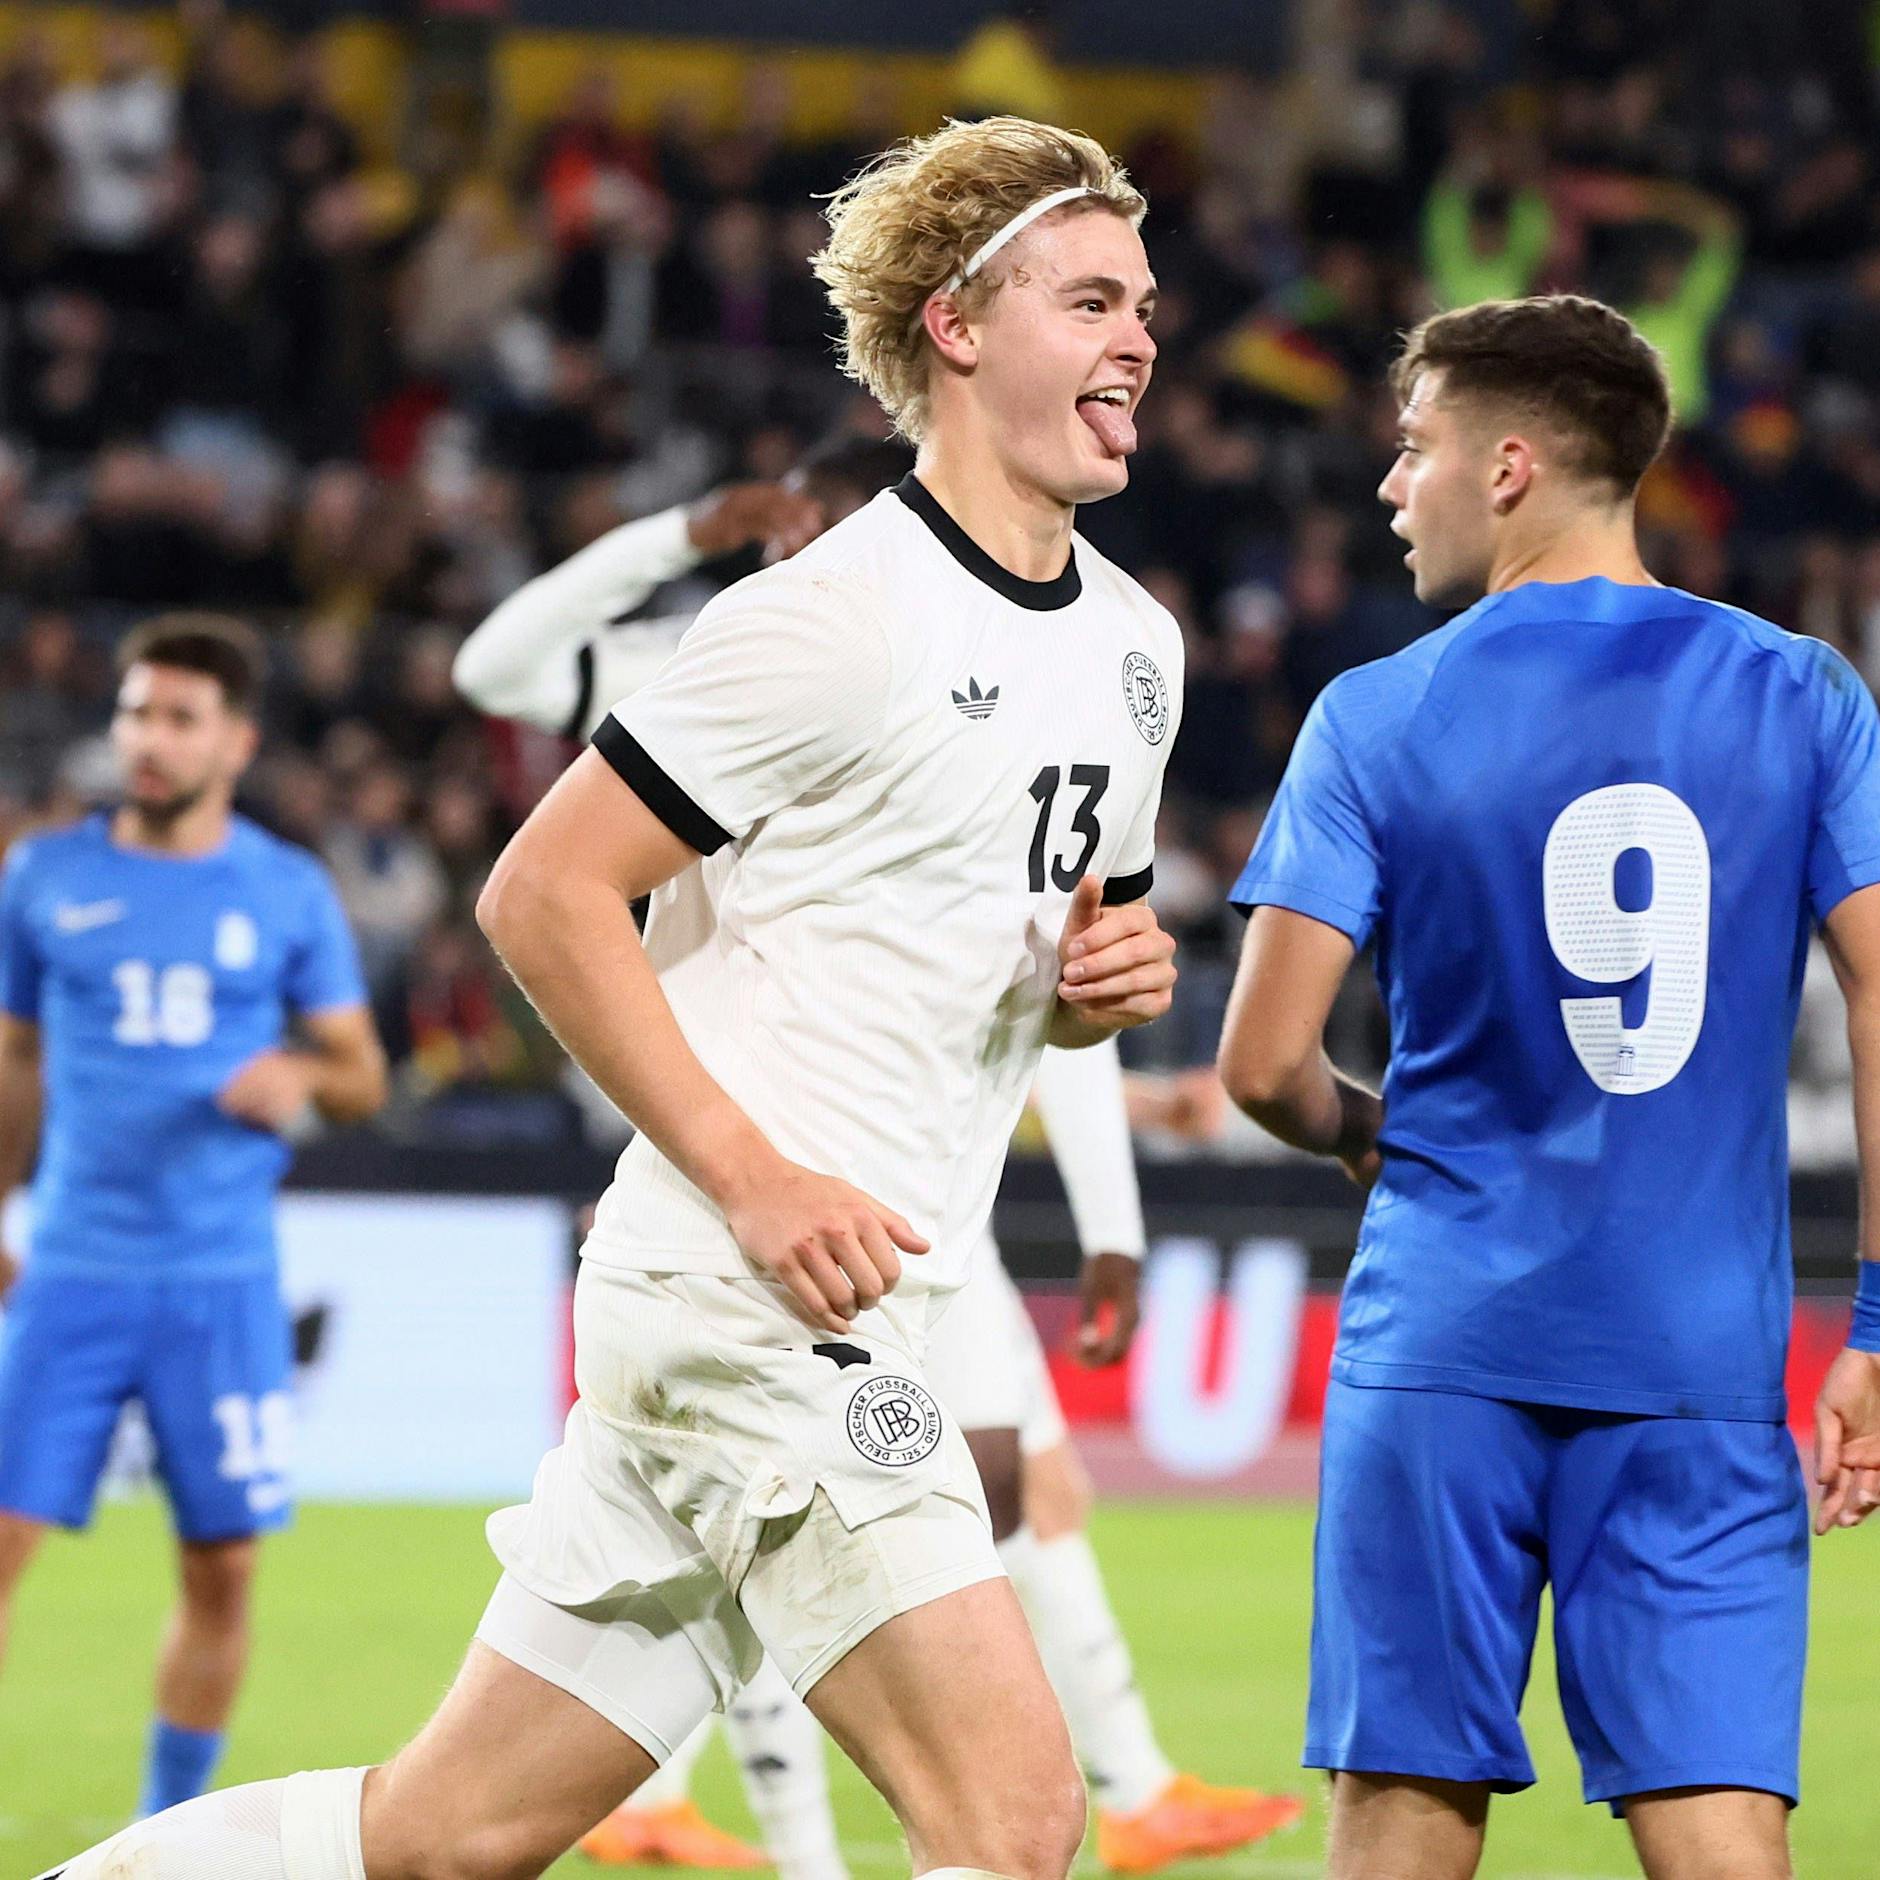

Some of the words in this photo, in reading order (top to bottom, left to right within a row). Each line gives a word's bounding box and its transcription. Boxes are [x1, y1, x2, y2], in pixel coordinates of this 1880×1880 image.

[1028, 764, 1110, 893] 13
[1542, 782, 1711, 1096] 9
[852, 1394, 891, 1461] DEUTSCHER
[868, 1380, 937, 1444] FUSSBALL-BUND
[902, 1447, 921, 1461] 125
